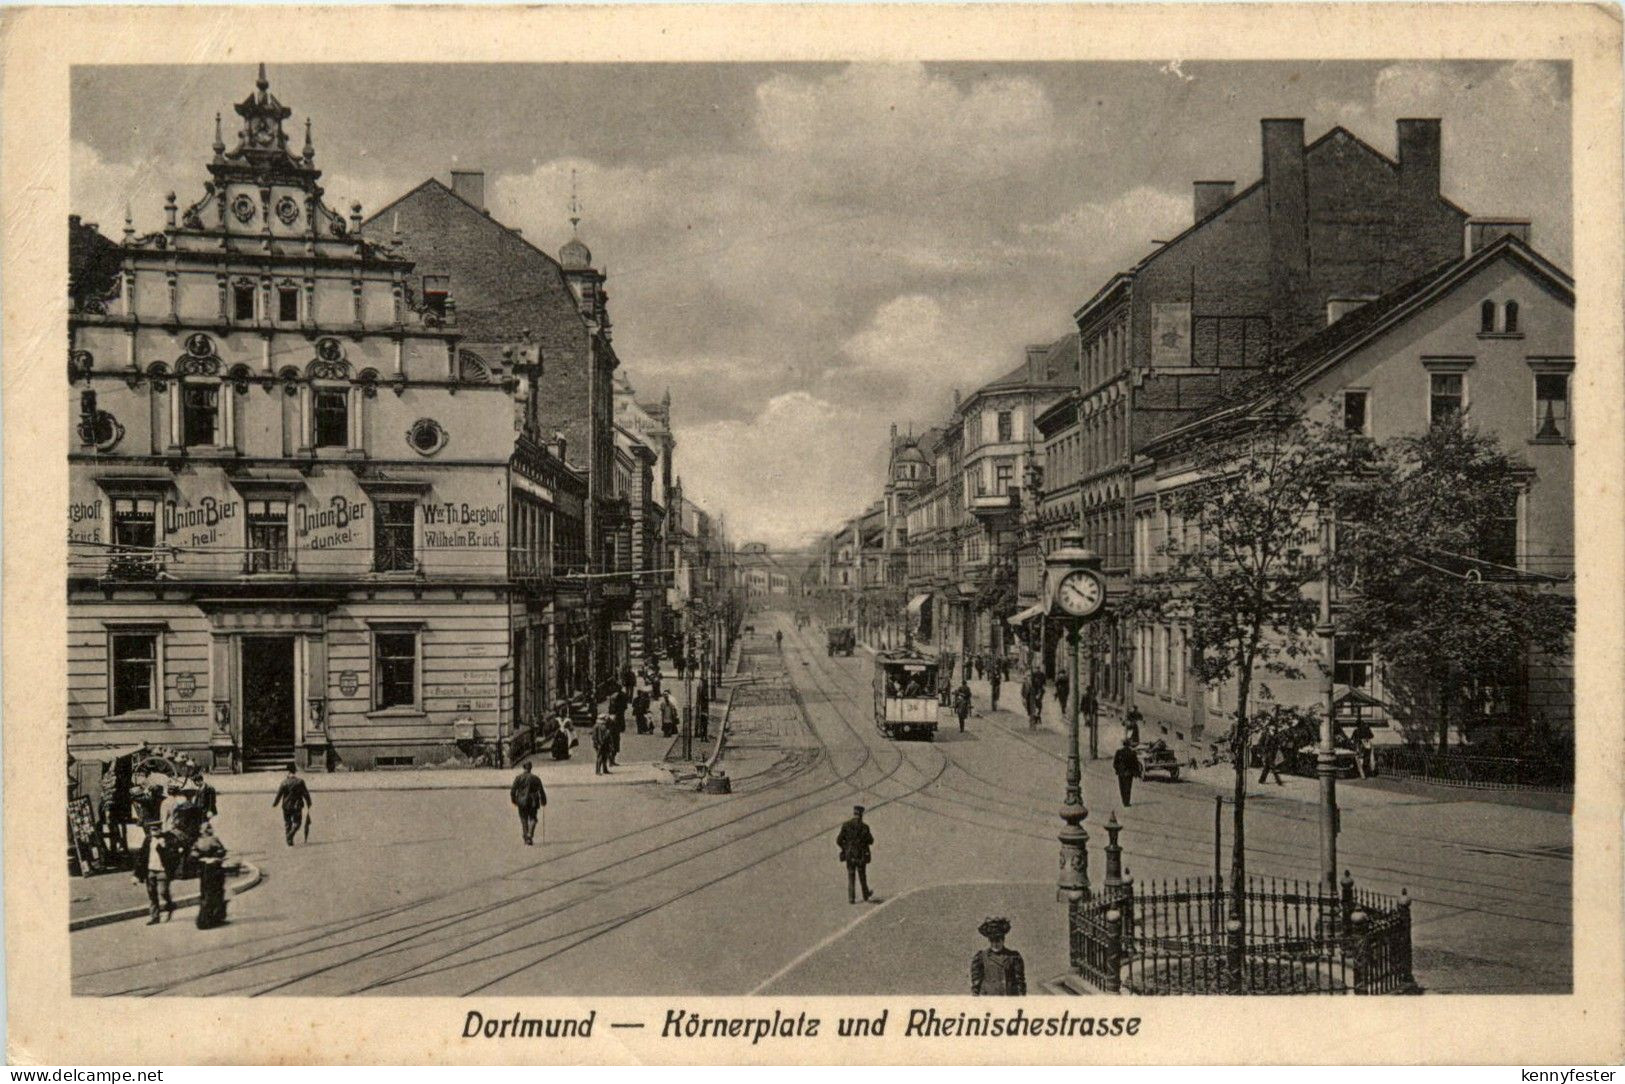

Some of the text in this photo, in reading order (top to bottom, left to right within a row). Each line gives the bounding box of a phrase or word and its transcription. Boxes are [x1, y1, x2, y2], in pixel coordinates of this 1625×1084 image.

[165, 497, 238, 534] Union Bier
[330, 495, 367, 528] Bier
[192, 530, 217, 547] hell
[311, 529, 352, 550] dunkel
[425, 531, 466, 548] Wilhelm
